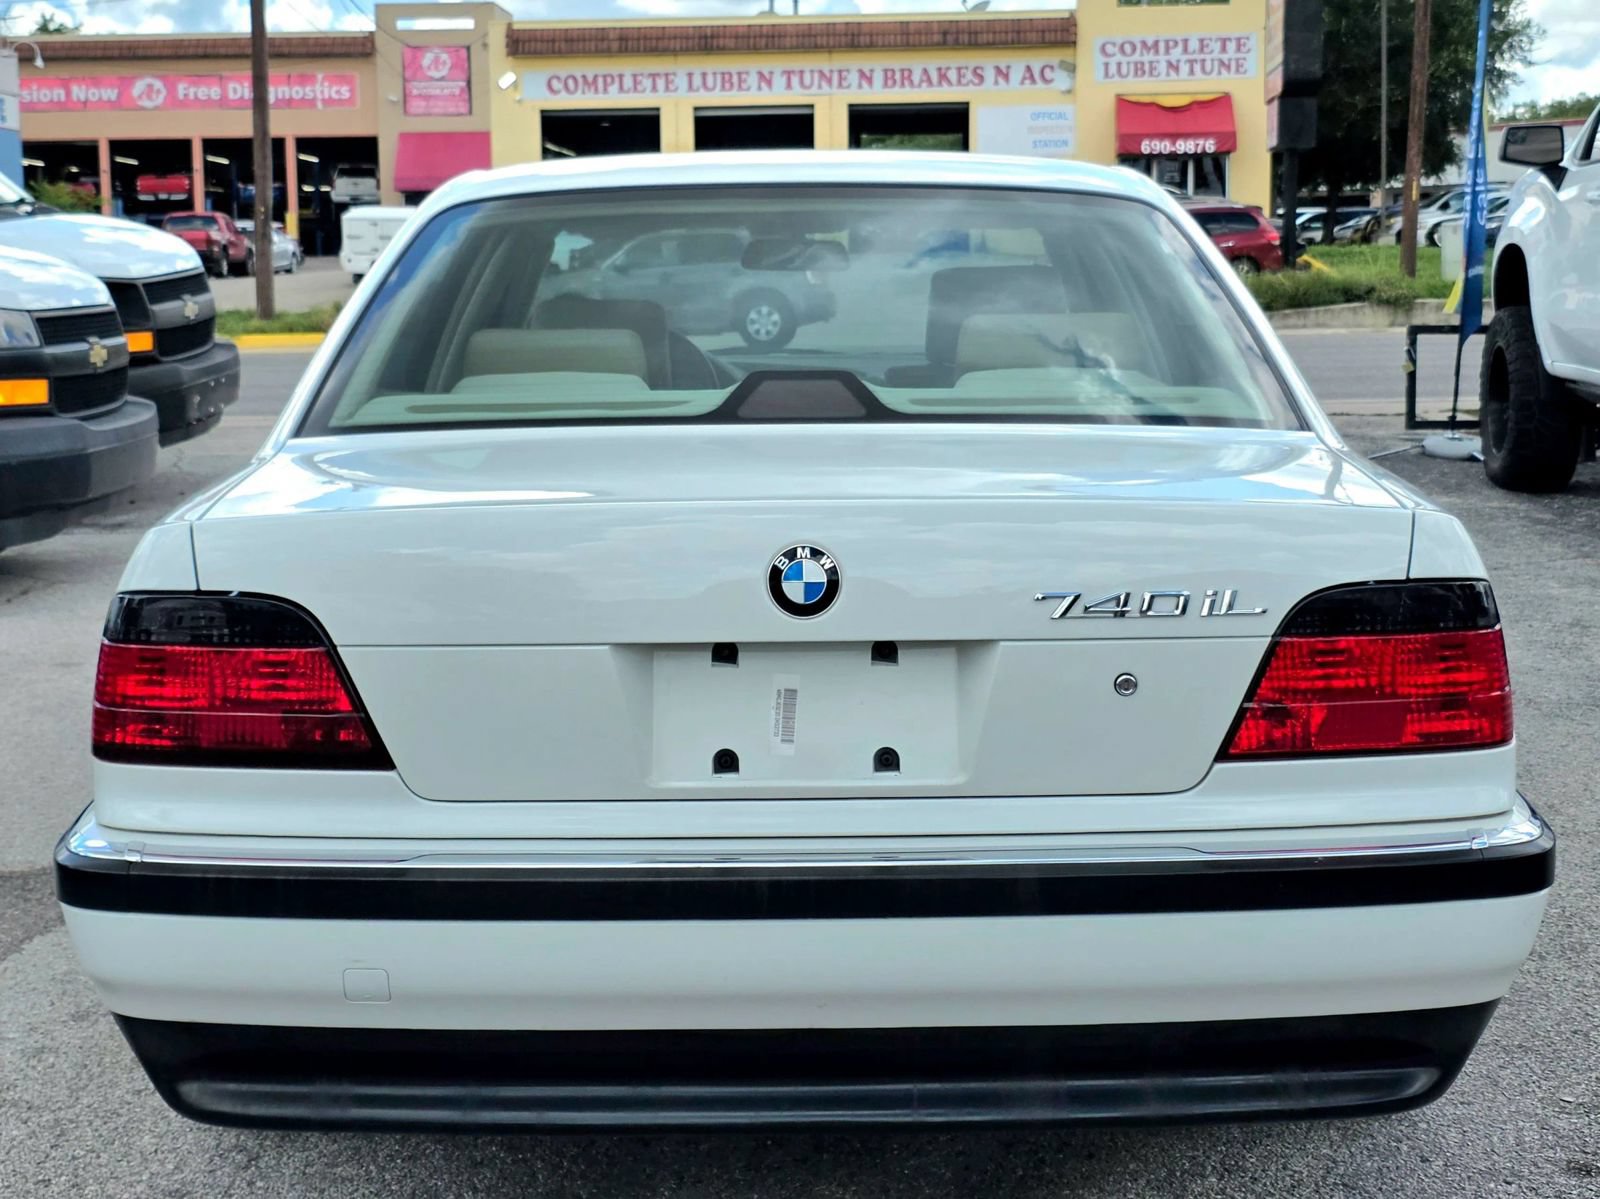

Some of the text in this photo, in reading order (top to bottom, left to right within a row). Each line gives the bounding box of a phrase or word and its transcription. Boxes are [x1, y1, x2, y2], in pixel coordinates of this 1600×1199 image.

[1100, 36, 1252, 58] COMPLETE
[1102, 57, 1248, 79] LUBE N TUNE
[546, 64, 1056, 95] COMPLETE LUBE N TUNE N BRAKES N AC
[71, 83, 119, 102] Now
[177, 82, 222, 101] Free
[227, 82, 352, 104] Dignostics
[1140, 138, 1216, 155] 690-9876
[774, 546, 835, 571] BMW
